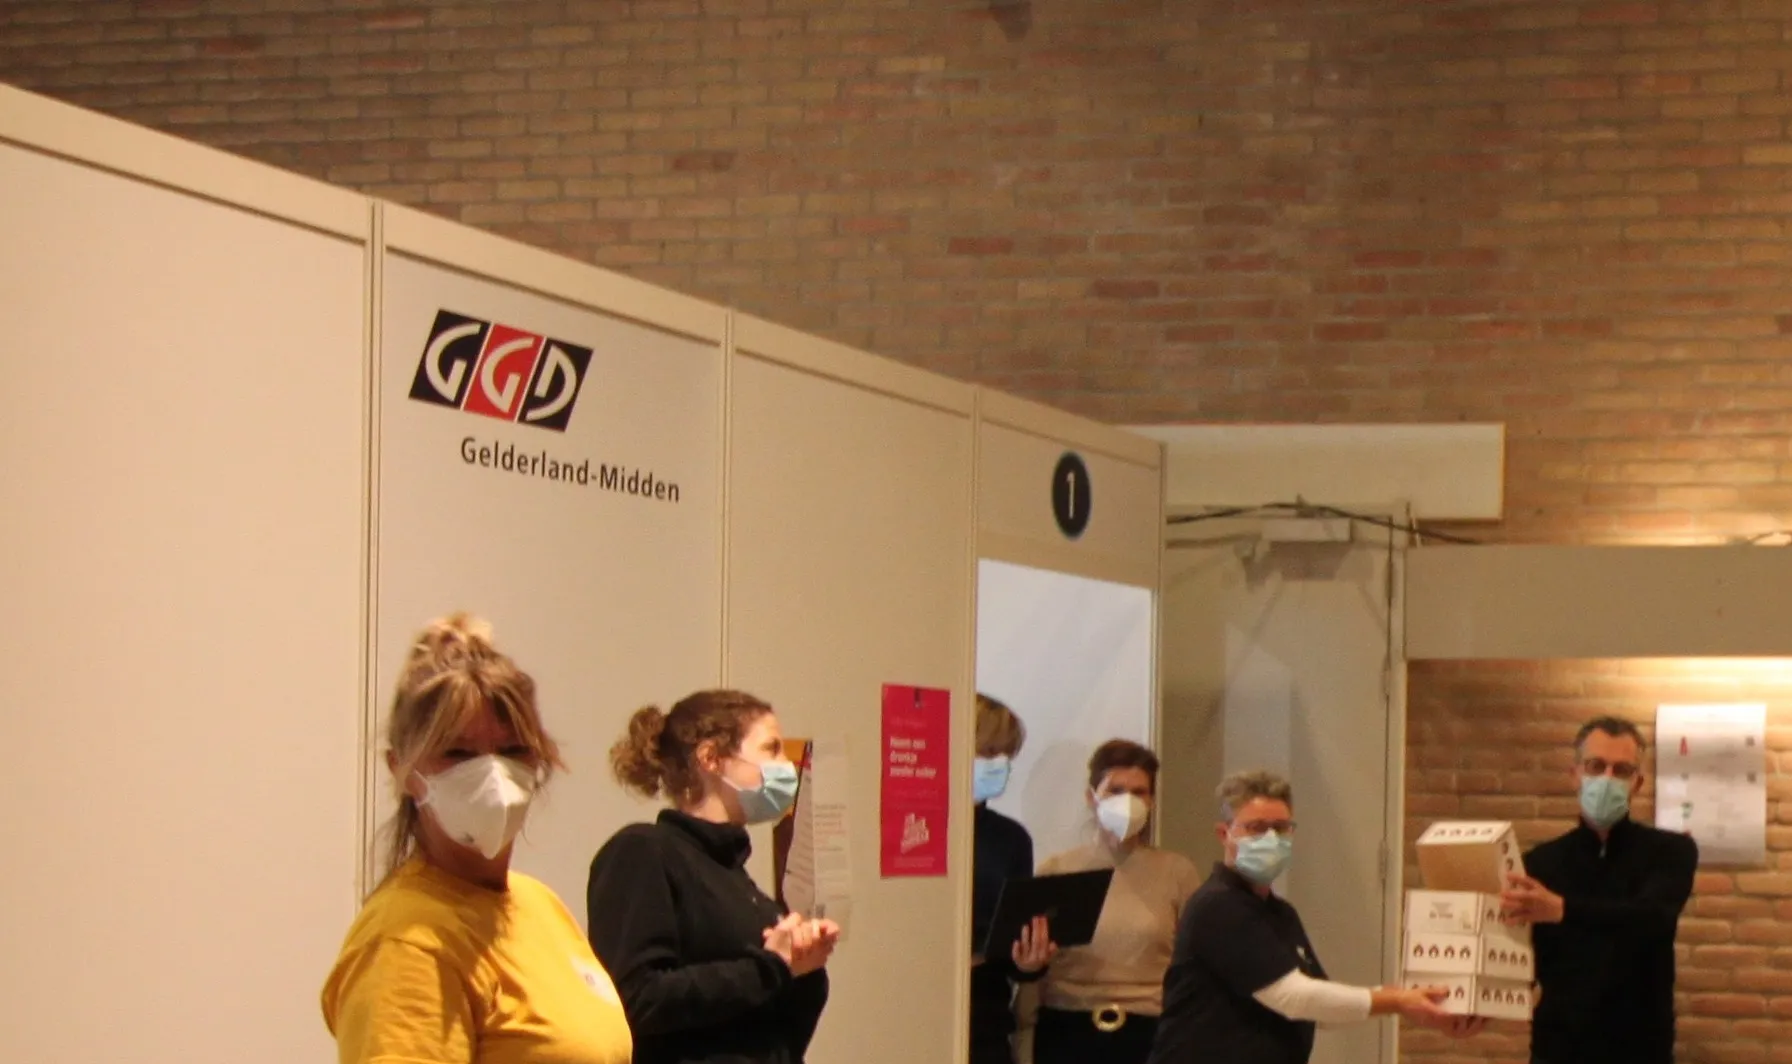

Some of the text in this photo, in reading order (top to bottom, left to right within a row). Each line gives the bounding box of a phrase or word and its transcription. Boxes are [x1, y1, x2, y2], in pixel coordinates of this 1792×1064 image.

[423, 321, 578, 423] GGD
[460, 436, 681, 503] Gelderland-Midden
[1065, 470, 1076, 520] 1
